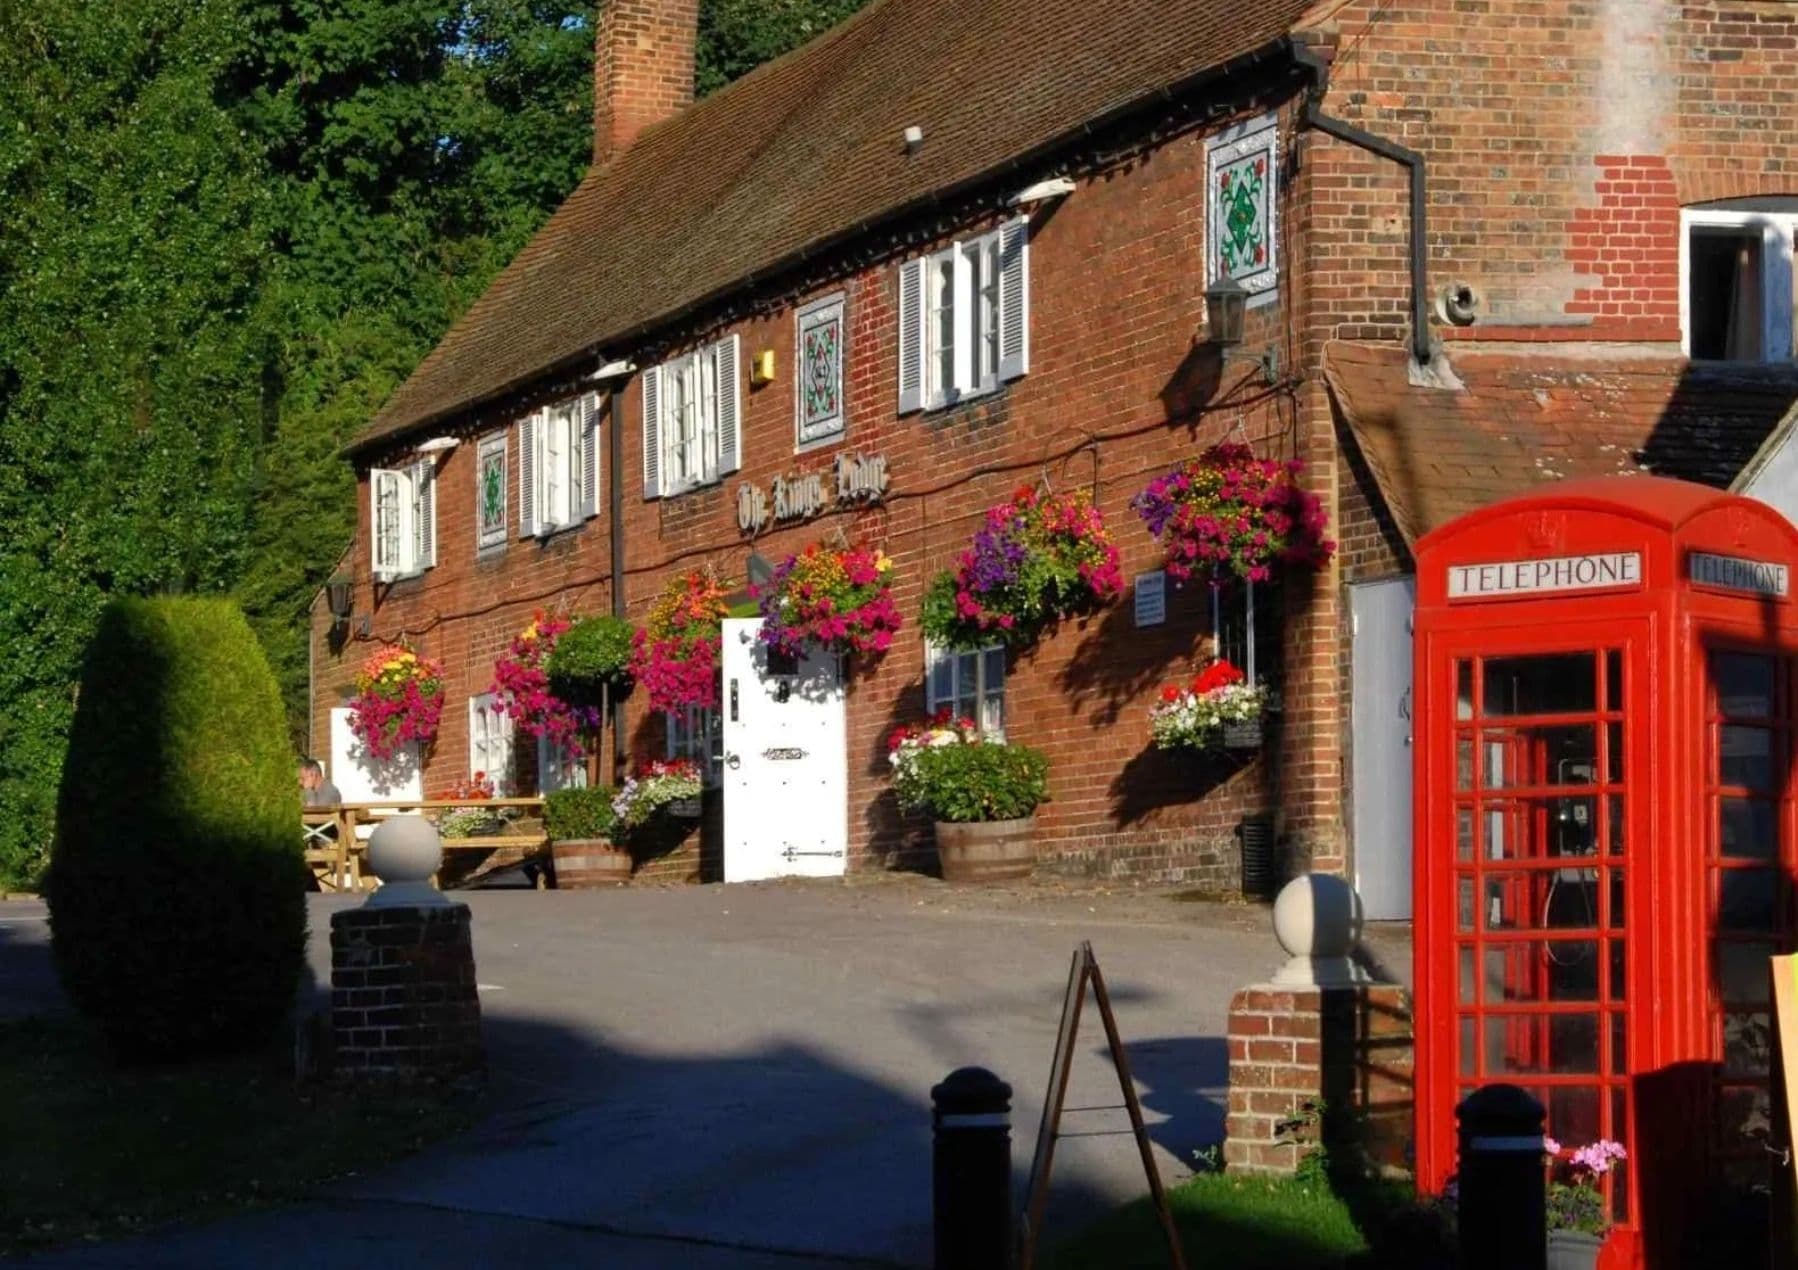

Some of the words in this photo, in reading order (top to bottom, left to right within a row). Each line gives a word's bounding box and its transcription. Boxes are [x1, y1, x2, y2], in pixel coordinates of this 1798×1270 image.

[737, 481, 769, 535] The
[1458, 555, 1635, 593] TELEPHONE
[1693, 555, 1785, 593] TELEPHONE
